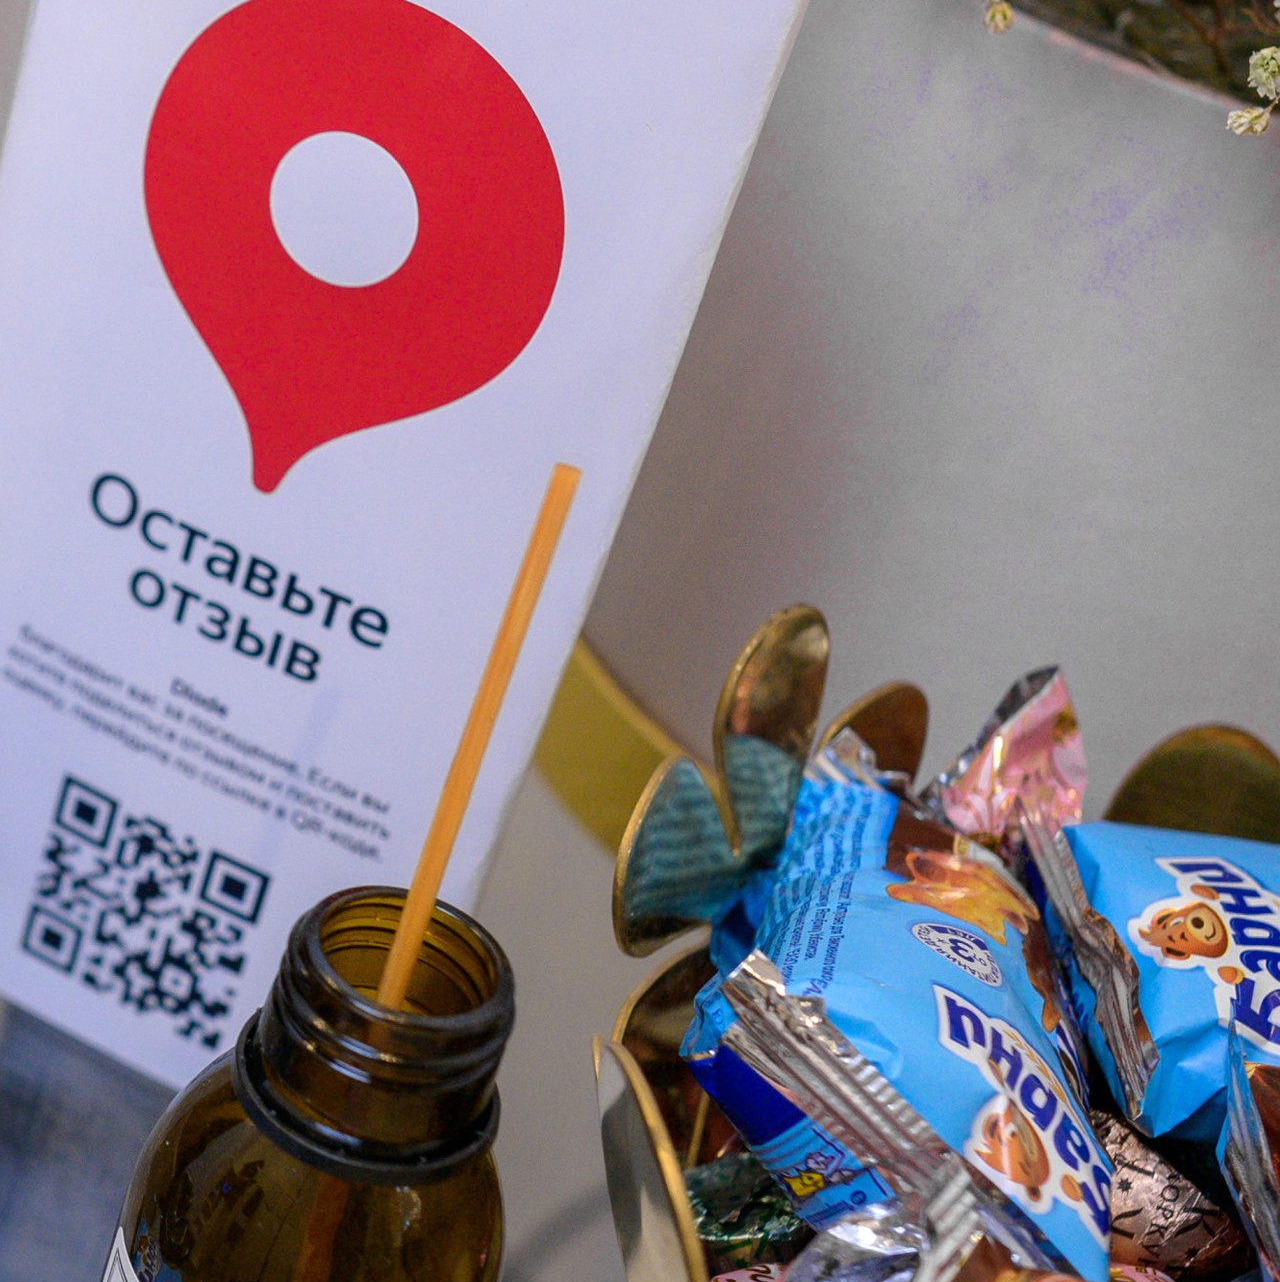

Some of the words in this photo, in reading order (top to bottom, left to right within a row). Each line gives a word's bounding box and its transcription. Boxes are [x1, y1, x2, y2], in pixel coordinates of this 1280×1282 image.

[89, 474, 390, 648] Оставьте
[129, 569, 323, 683] отзыв
[284, 784, 392, 840] поставить
[305, 767, 359, 804] Если
[360, 792, 391, 815] вы
